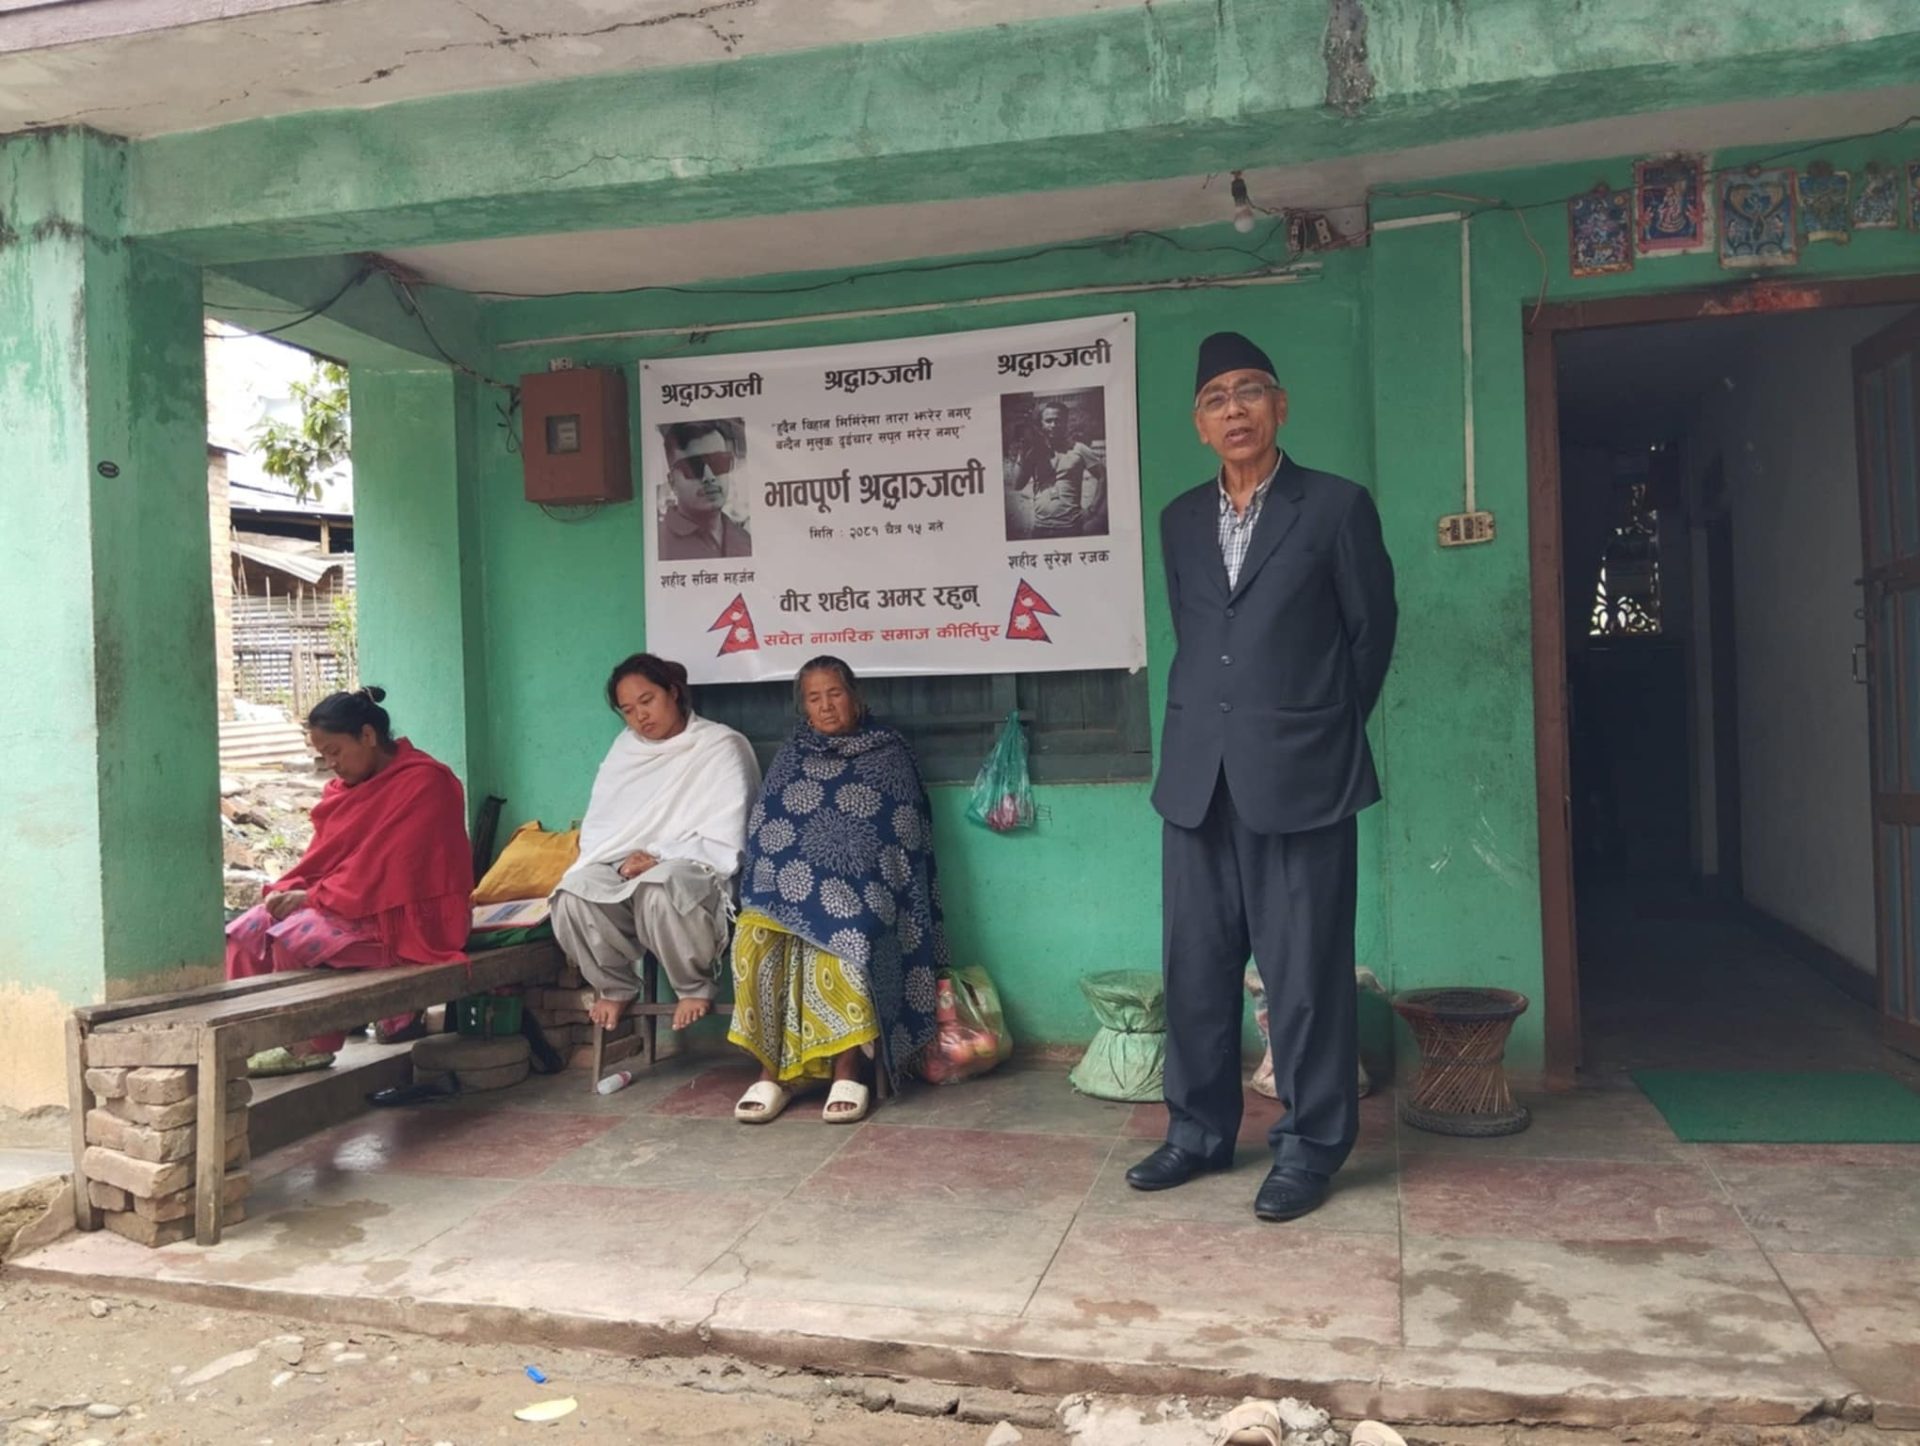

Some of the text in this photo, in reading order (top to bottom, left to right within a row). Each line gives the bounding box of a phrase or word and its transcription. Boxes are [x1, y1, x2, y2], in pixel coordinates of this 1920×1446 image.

[765, 458, 986, 513] भावपूर्ण श्रद्धाञ्जली
[809, 526, 833, 538] मिति
[928, 520, 944, 531] गते
[1008, 550, 1110, 570] शहीद सुरेश रजक
[661, 571, 687, 588] शहीद
[780, 585, 980, 612] वीर शहीद अमर रहुन्
[764, 622, 1000, 646] सचेत नागरिक समाज कीर्तिपुर
